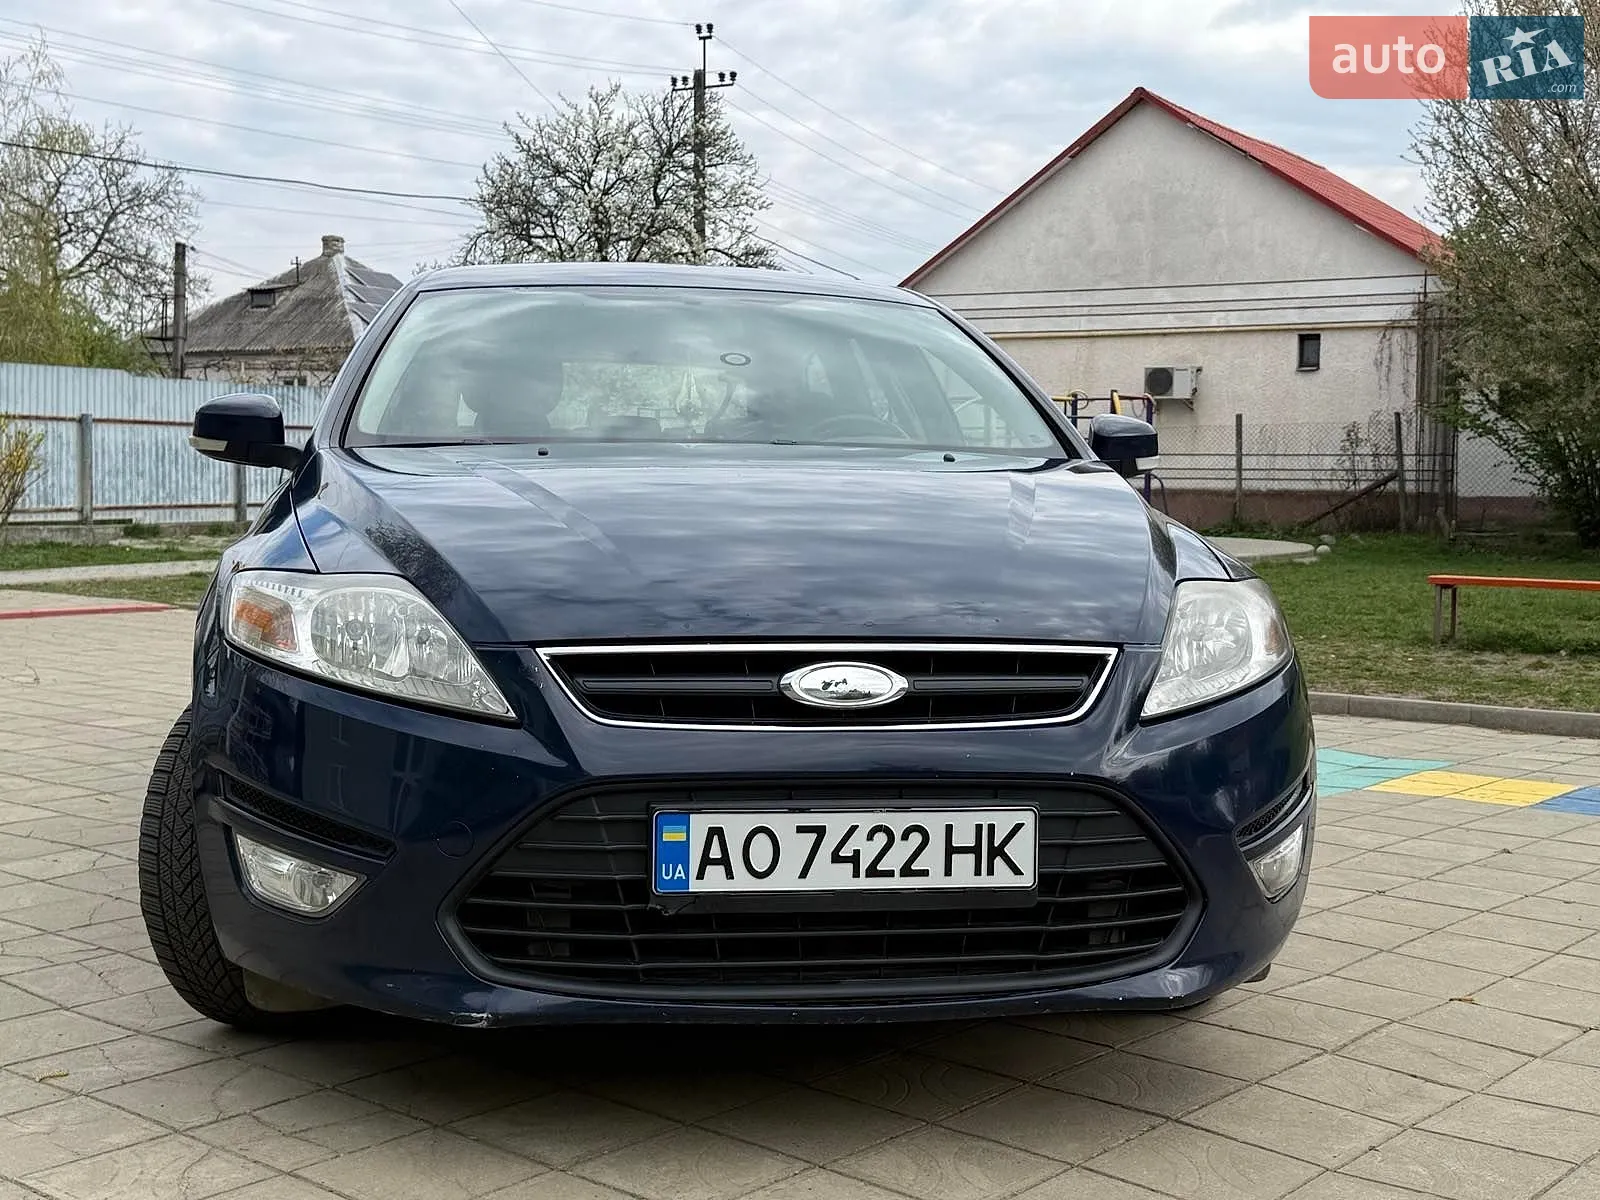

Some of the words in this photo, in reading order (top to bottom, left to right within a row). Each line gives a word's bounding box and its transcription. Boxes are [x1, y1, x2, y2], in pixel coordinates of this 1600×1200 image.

[695, 825, 781, 880] AO
[795, 824, 931, 879] 7422
[943, 822, 1026, 877] HK
[661, 863, 686, 880] UA
